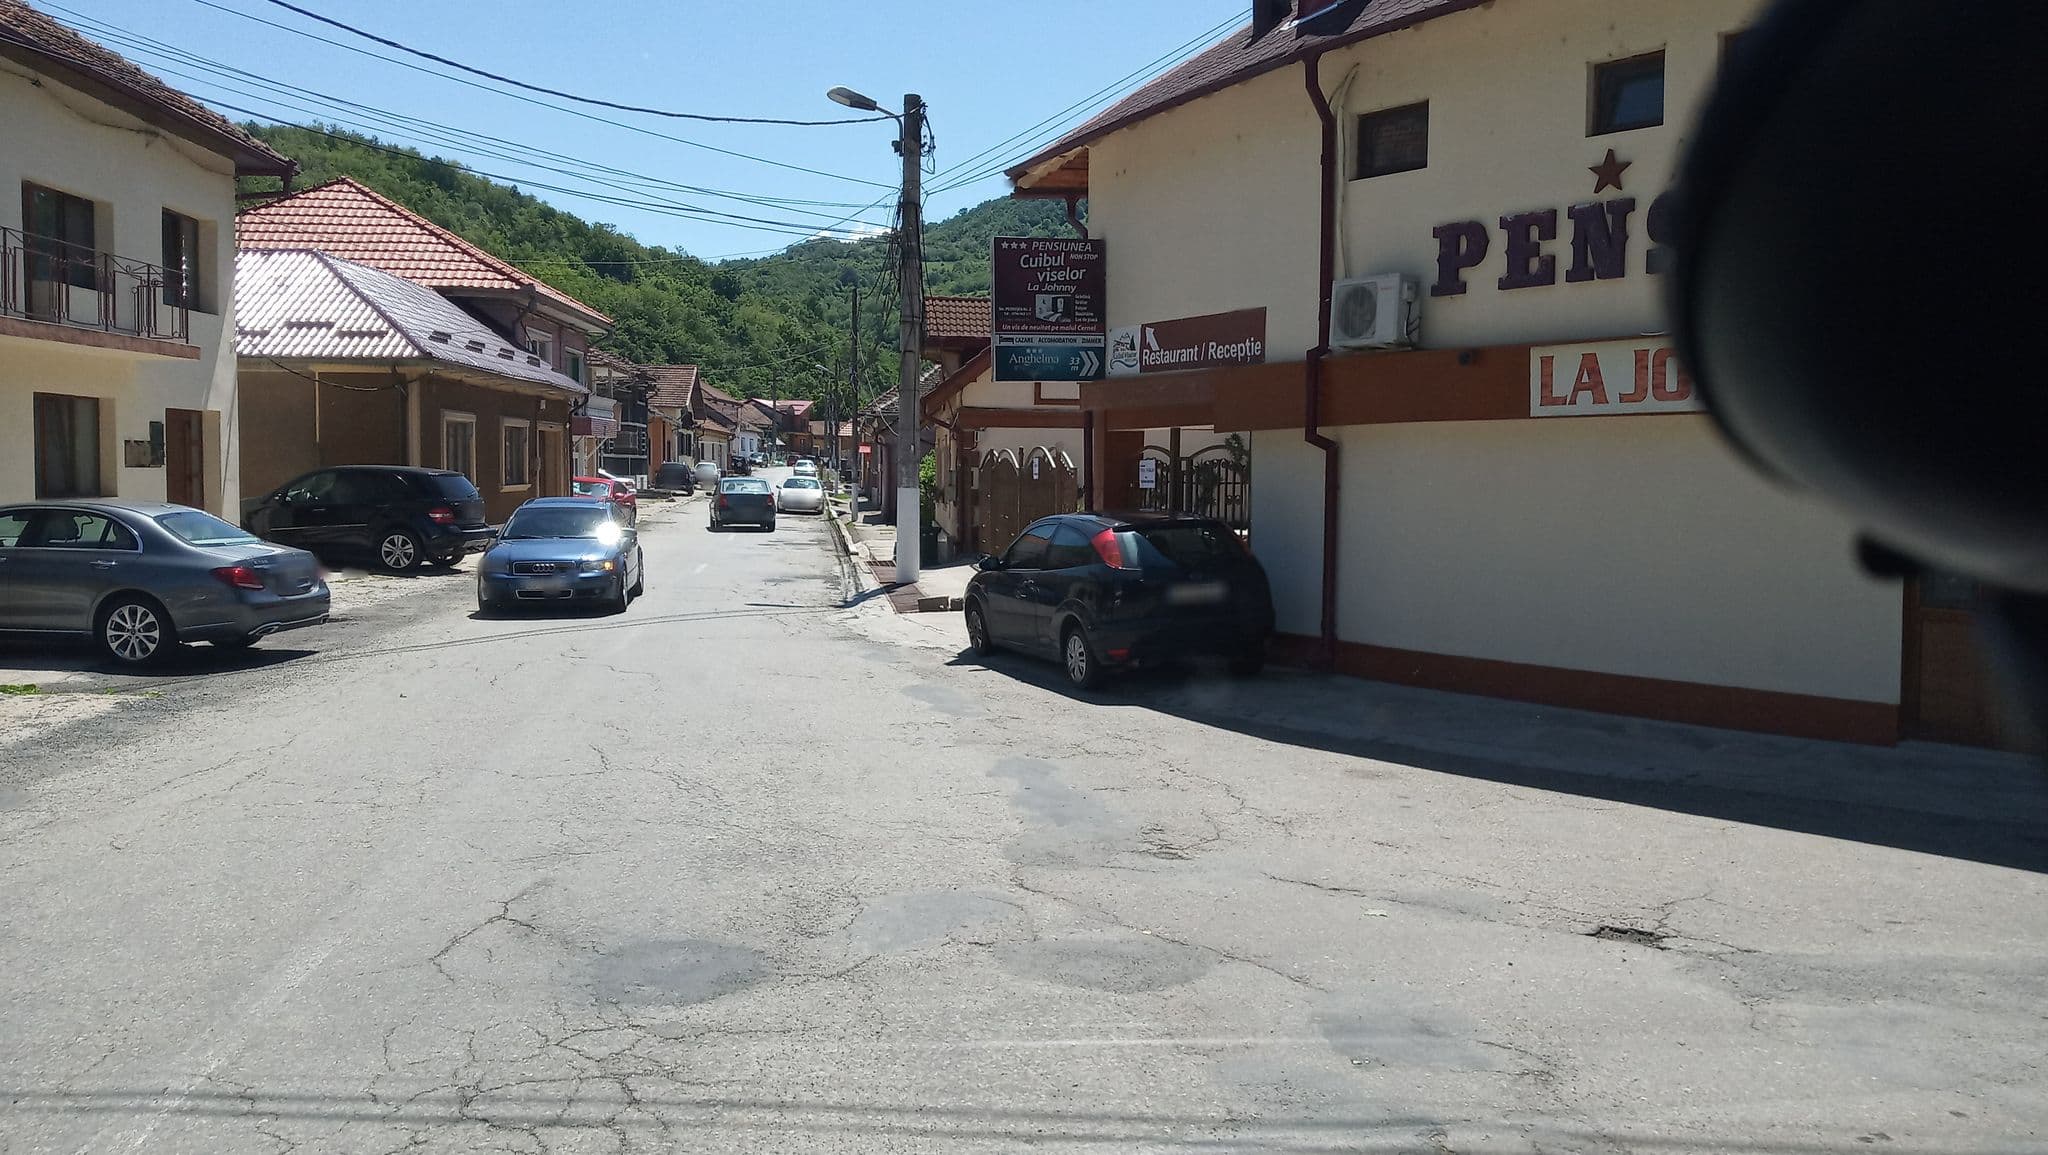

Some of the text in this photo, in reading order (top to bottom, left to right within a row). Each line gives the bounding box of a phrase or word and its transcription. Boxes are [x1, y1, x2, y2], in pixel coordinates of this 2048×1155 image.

[1031, 241, 1093, 252] PENSIUNEA
[1020, 252, 1065, 268] Cuibul
[1037, 267, 1086, 282] viselor
[1027, 282, 1077, 294] La Johnny
[1015, 336, 1034, 344] CAZARE
[1142, 344, 1198, 366] Restaurant
[1200, 342, 1206, 360] /
[1069, 356, 1080, 366] 33
[1539, 352, 1609, 407] LA
